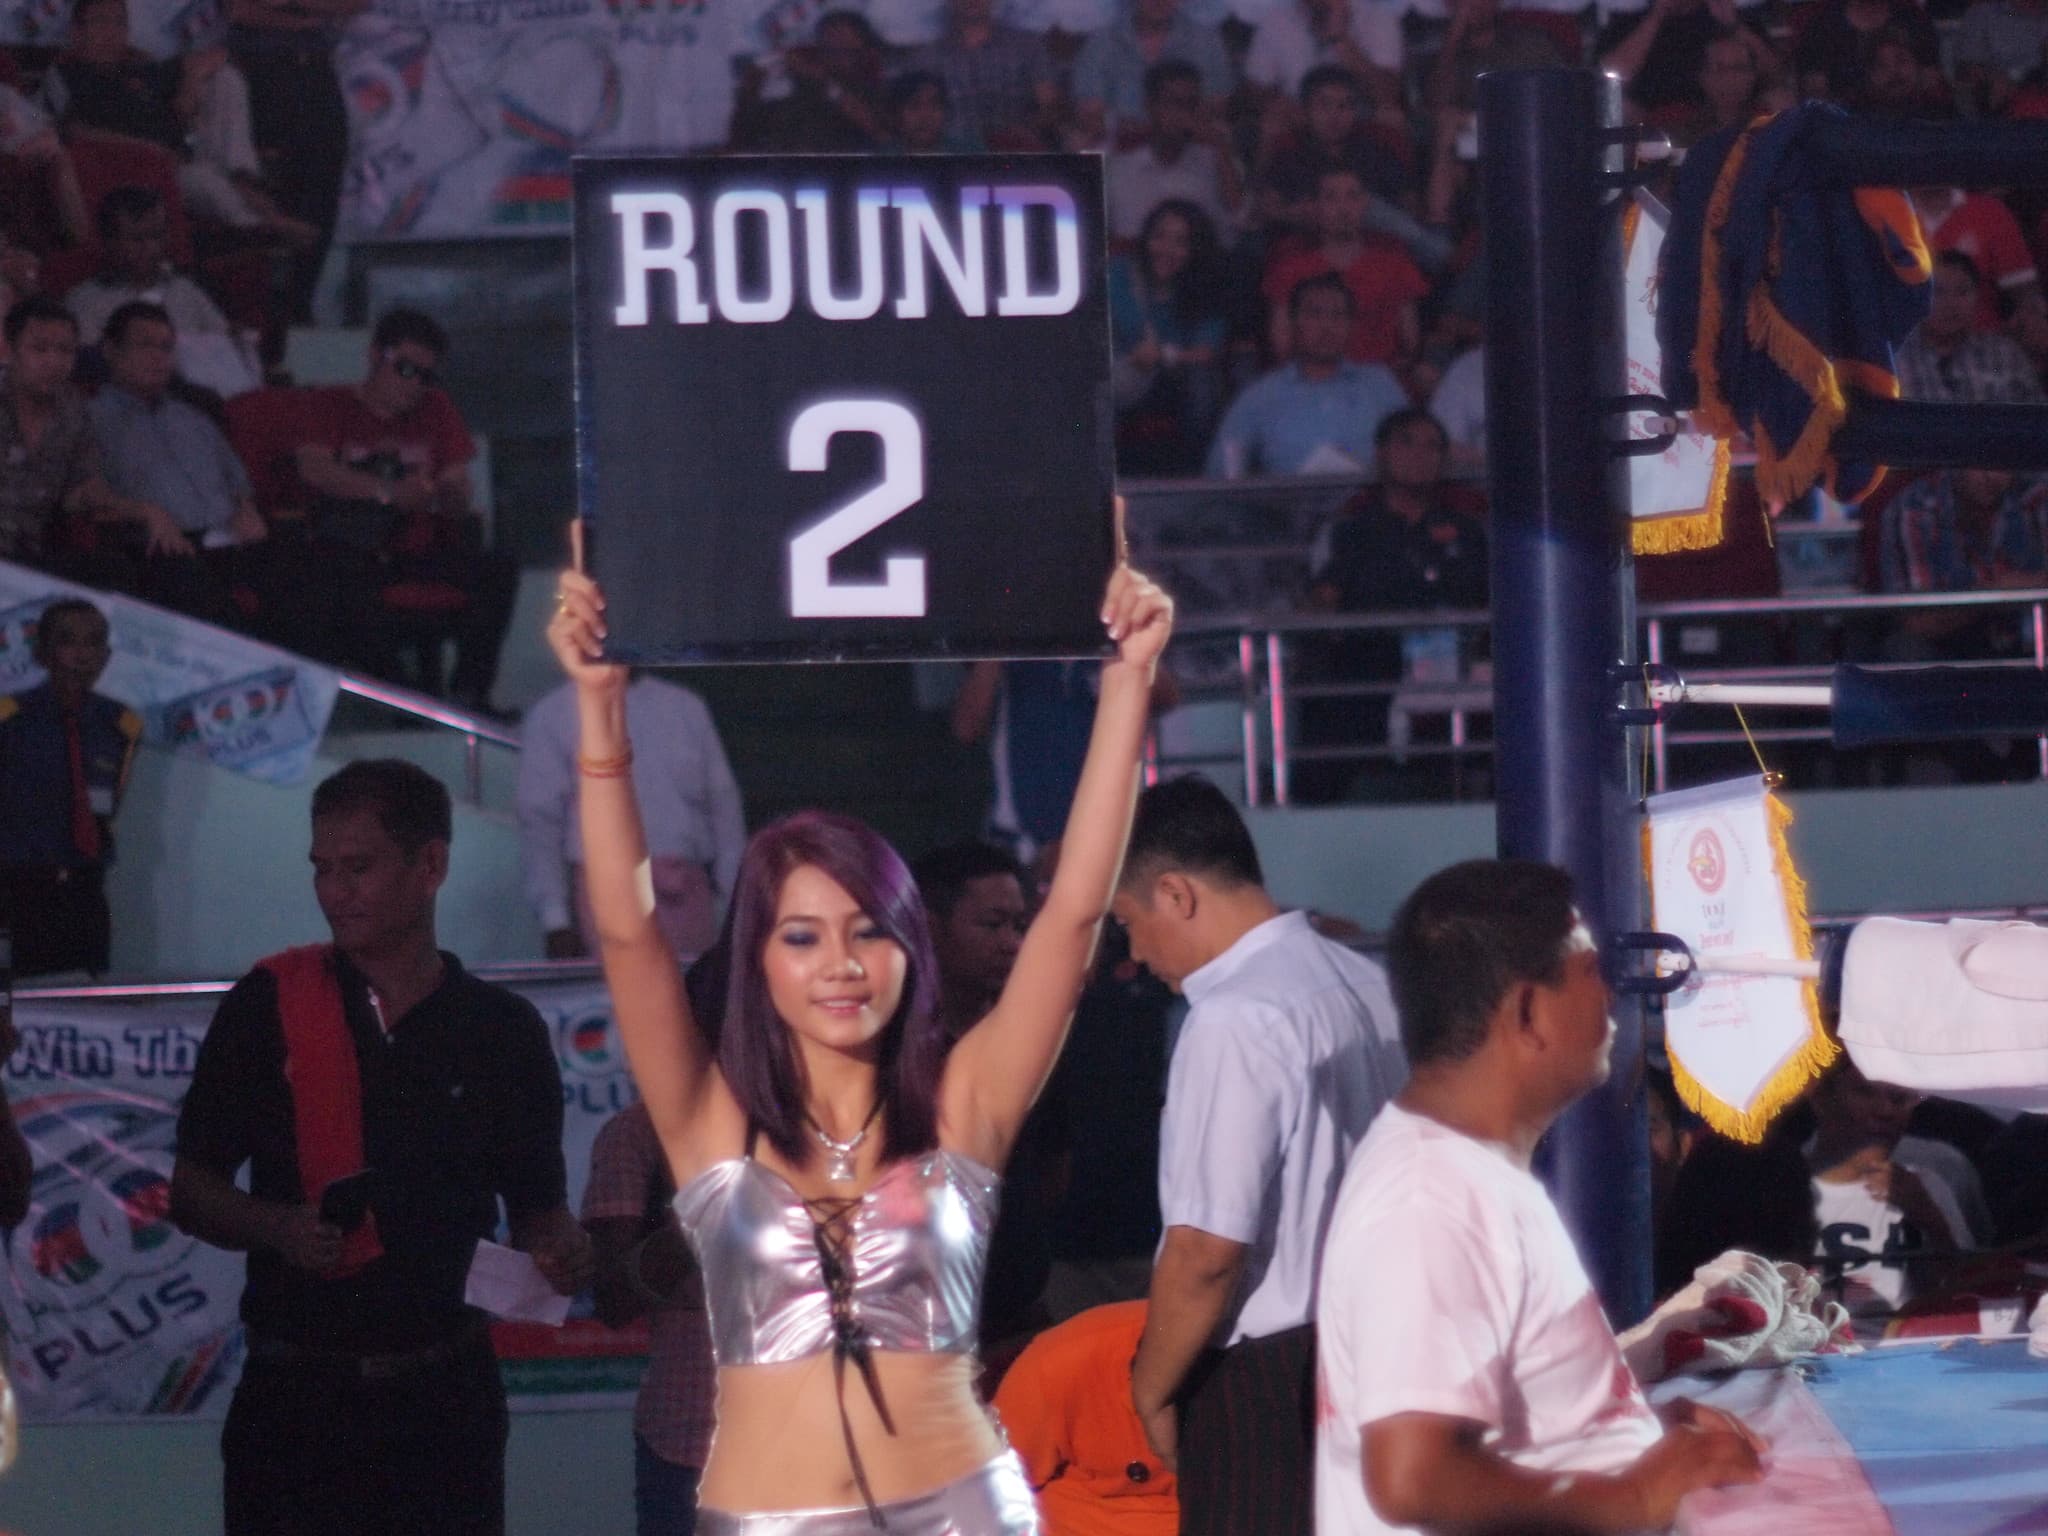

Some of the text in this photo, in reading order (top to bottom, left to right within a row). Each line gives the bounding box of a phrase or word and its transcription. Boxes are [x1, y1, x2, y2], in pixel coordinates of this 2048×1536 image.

[611, 185, 1081, 326] ROUND
[788, 399, 926, 618] 2
[8, 1024, 114, 1079] Win
[33, 1273, 208, 1382] PLUS
